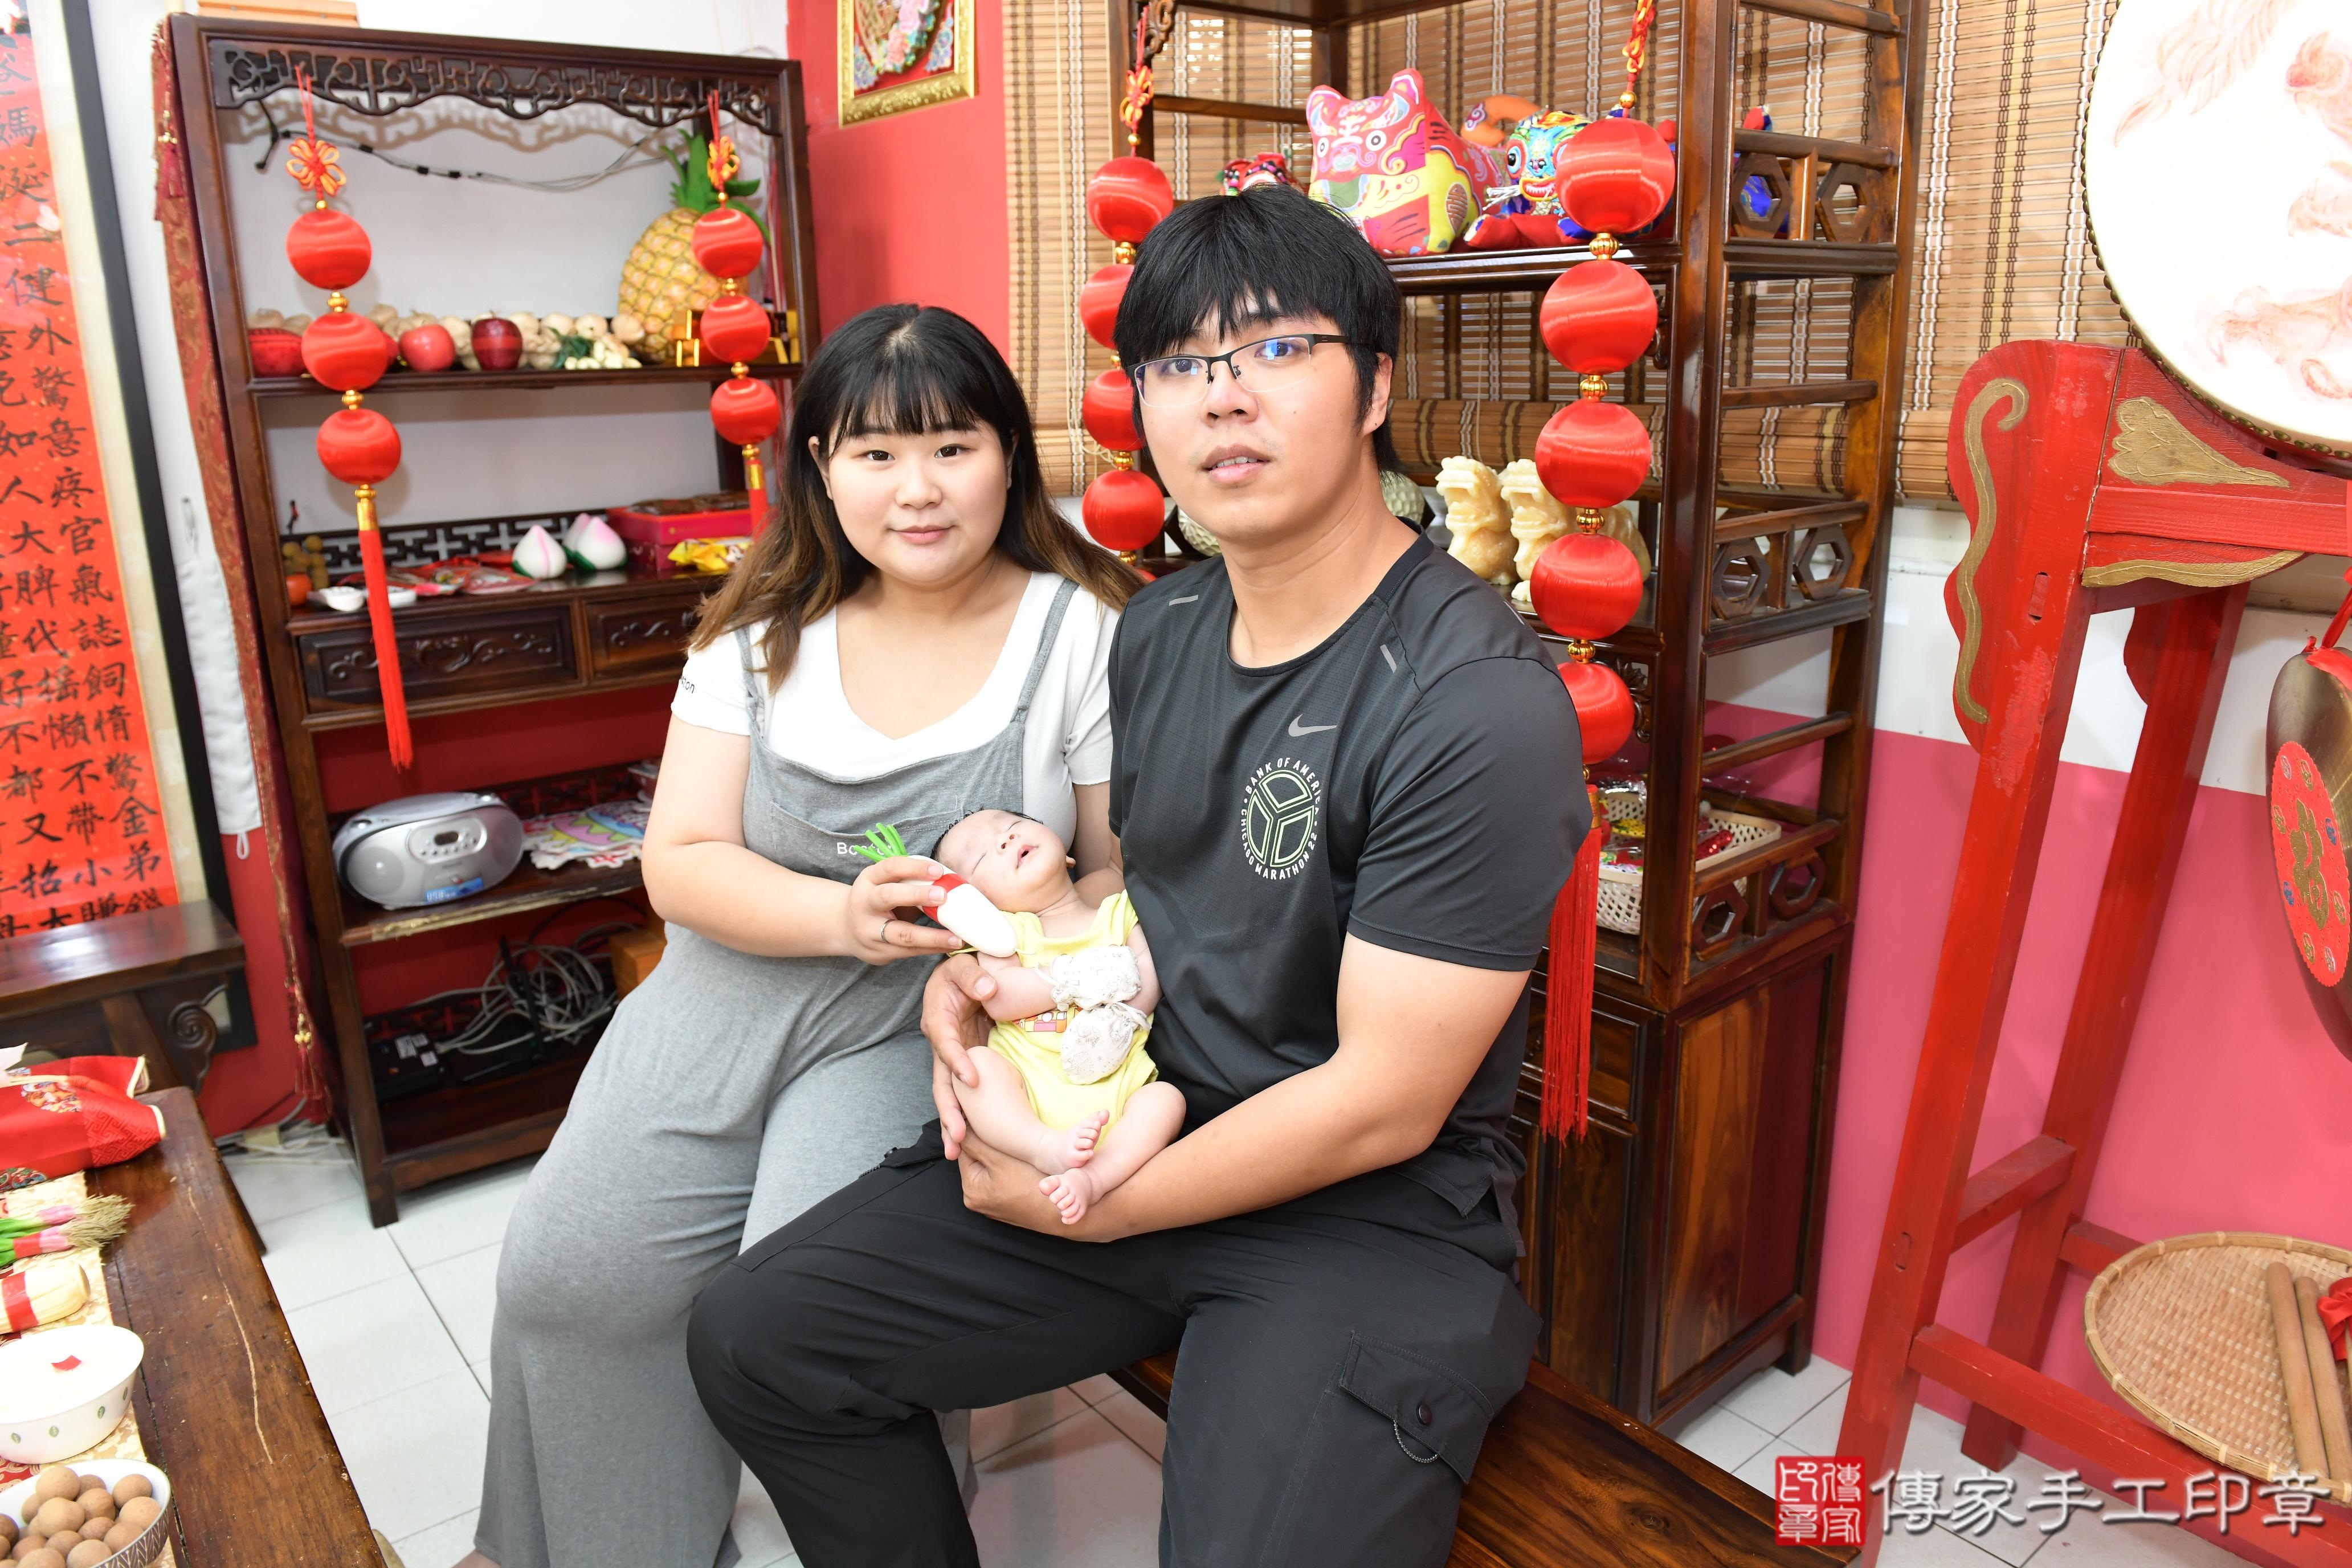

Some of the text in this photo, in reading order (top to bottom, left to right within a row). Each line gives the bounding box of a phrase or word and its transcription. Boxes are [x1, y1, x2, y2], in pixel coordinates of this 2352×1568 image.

[1246, 757, 1321, 815] BANK OF AMERICA
[1241, 808, 1255, 865] CHICAGO
[1255, 851, 1309, 880] MARATHON
